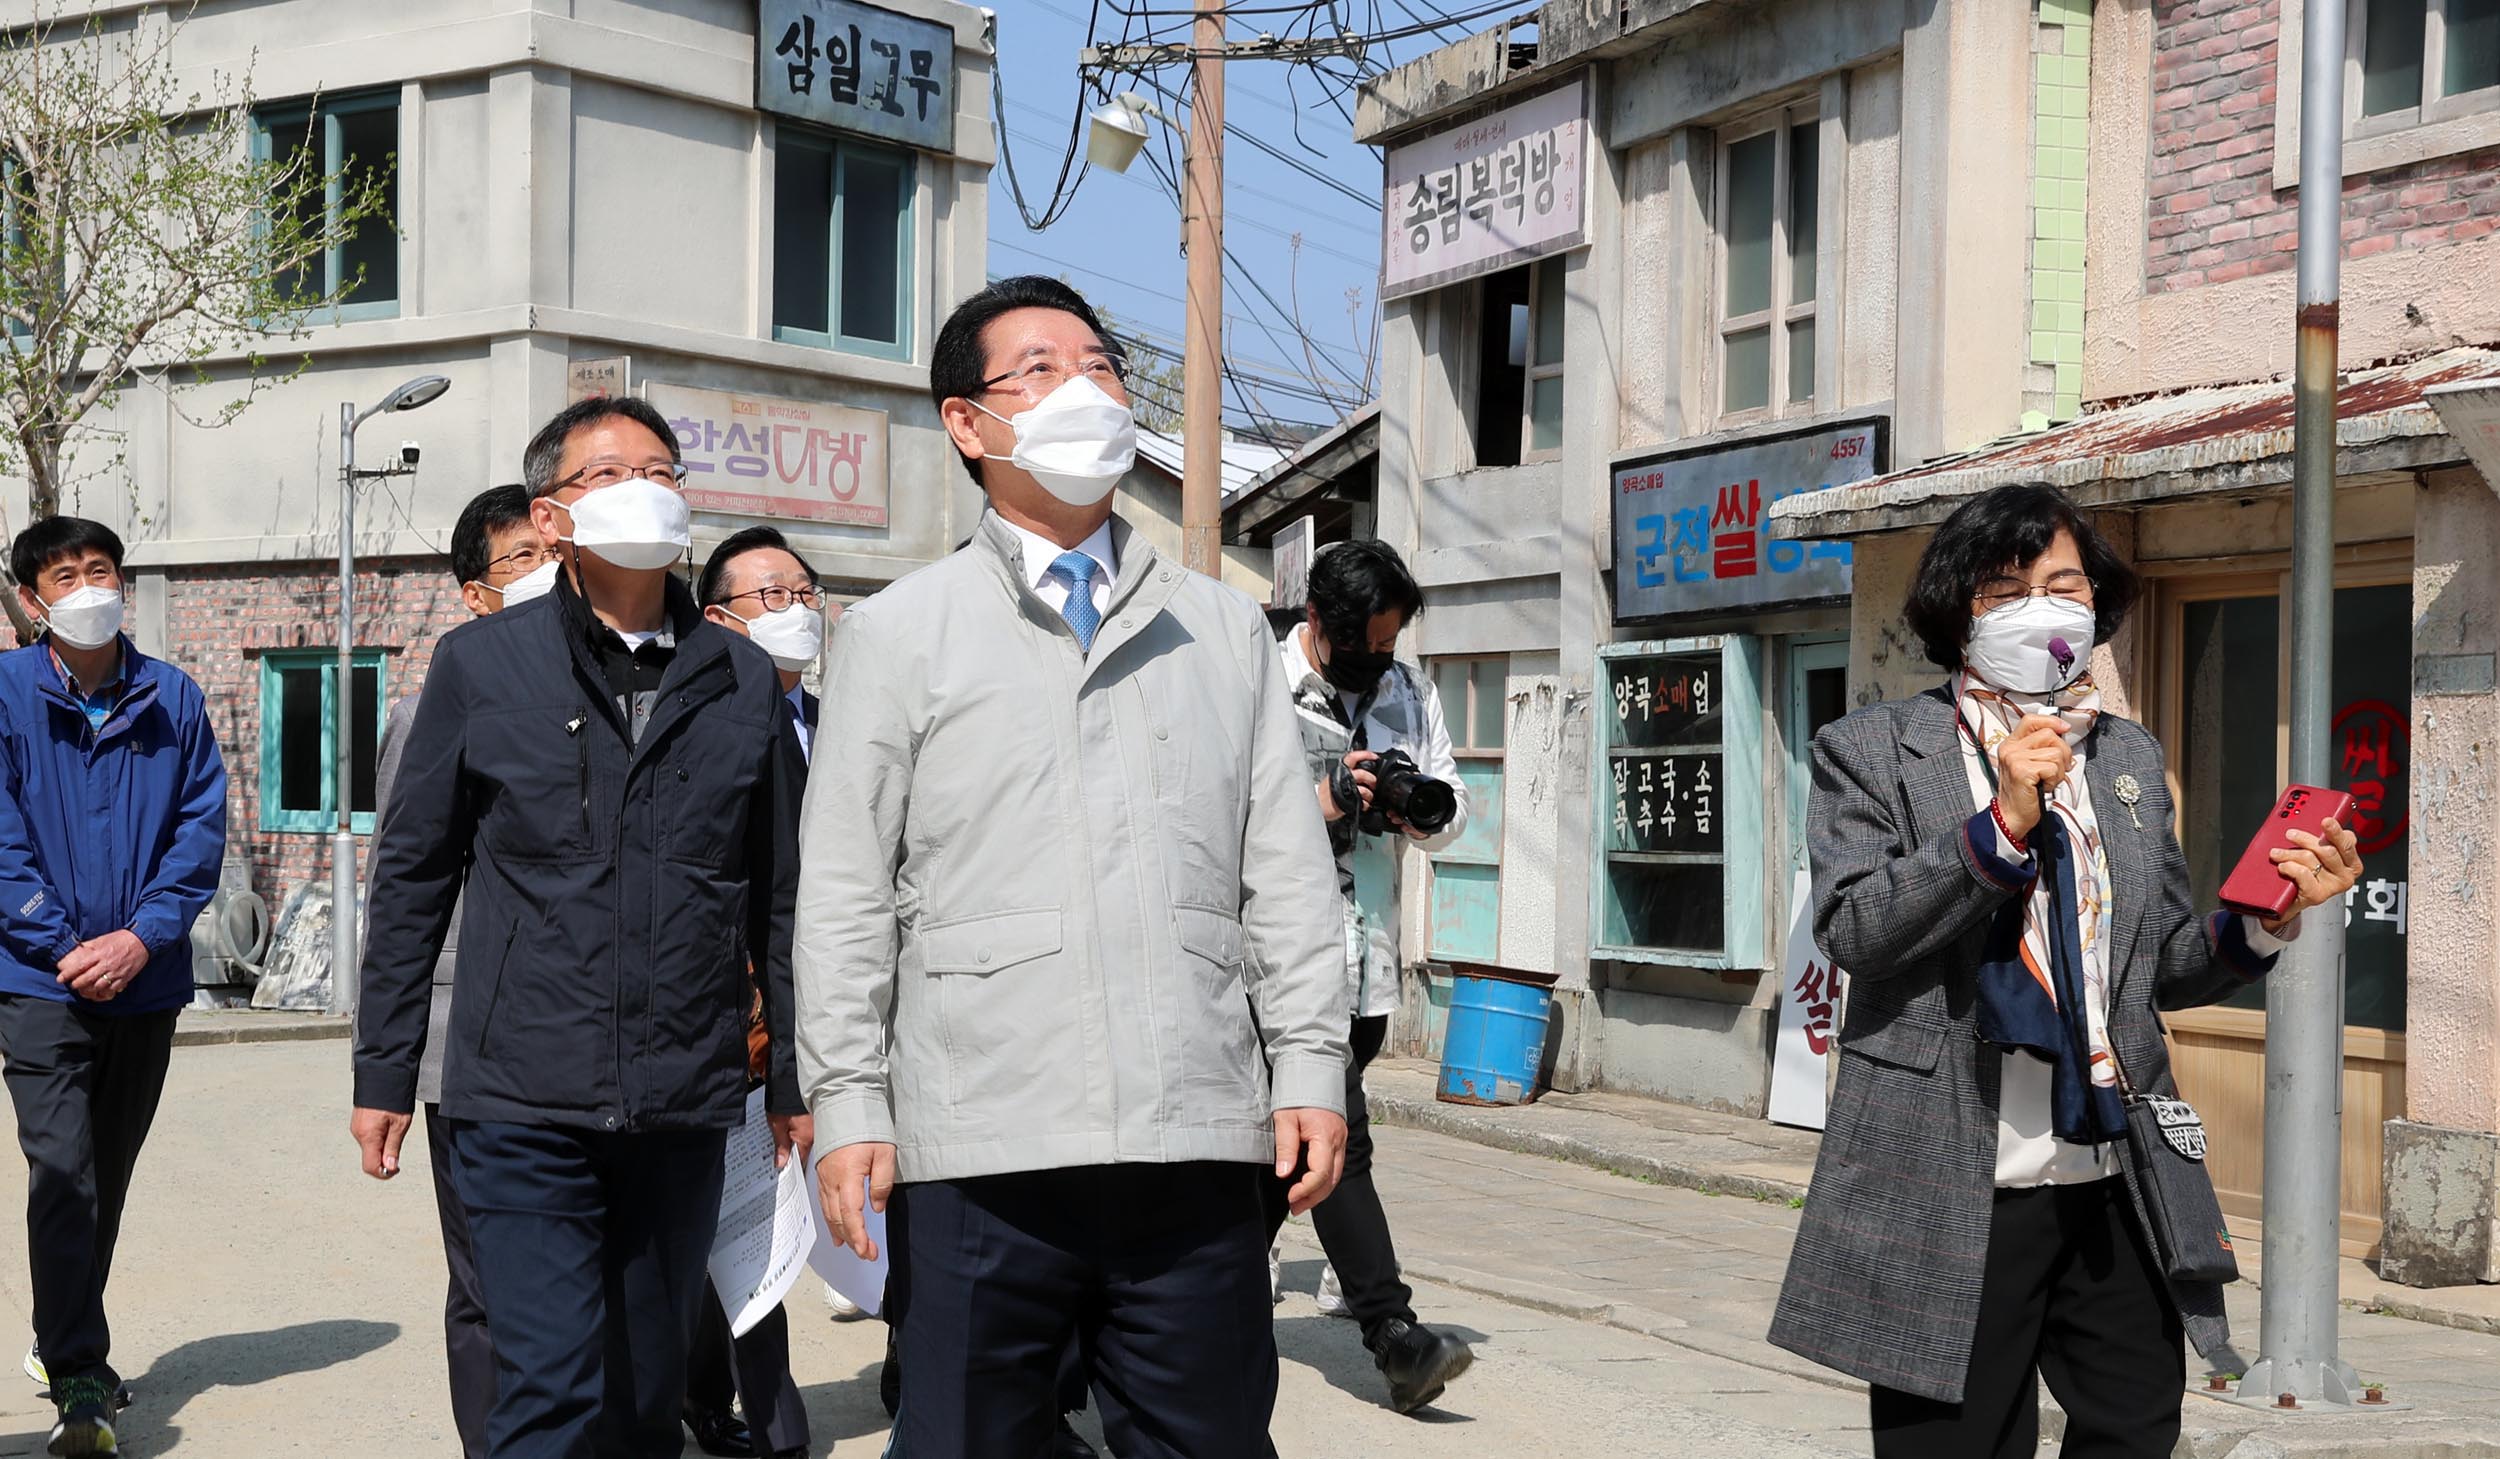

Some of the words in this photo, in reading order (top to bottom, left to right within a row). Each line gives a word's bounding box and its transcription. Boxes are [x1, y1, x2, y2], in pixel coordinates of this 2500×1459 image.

[1403, 128, 1562, 255] 송림복덕방
[668, 416, 868, 502] 한성다방
[1622, 471, 1664, 494] 양곡소매업
[1830, 436, 1866, 461] 4557
[1614, 670, 1710, 722] 양곡소매업
[1792, 959, 1842, 1056] 쌀
